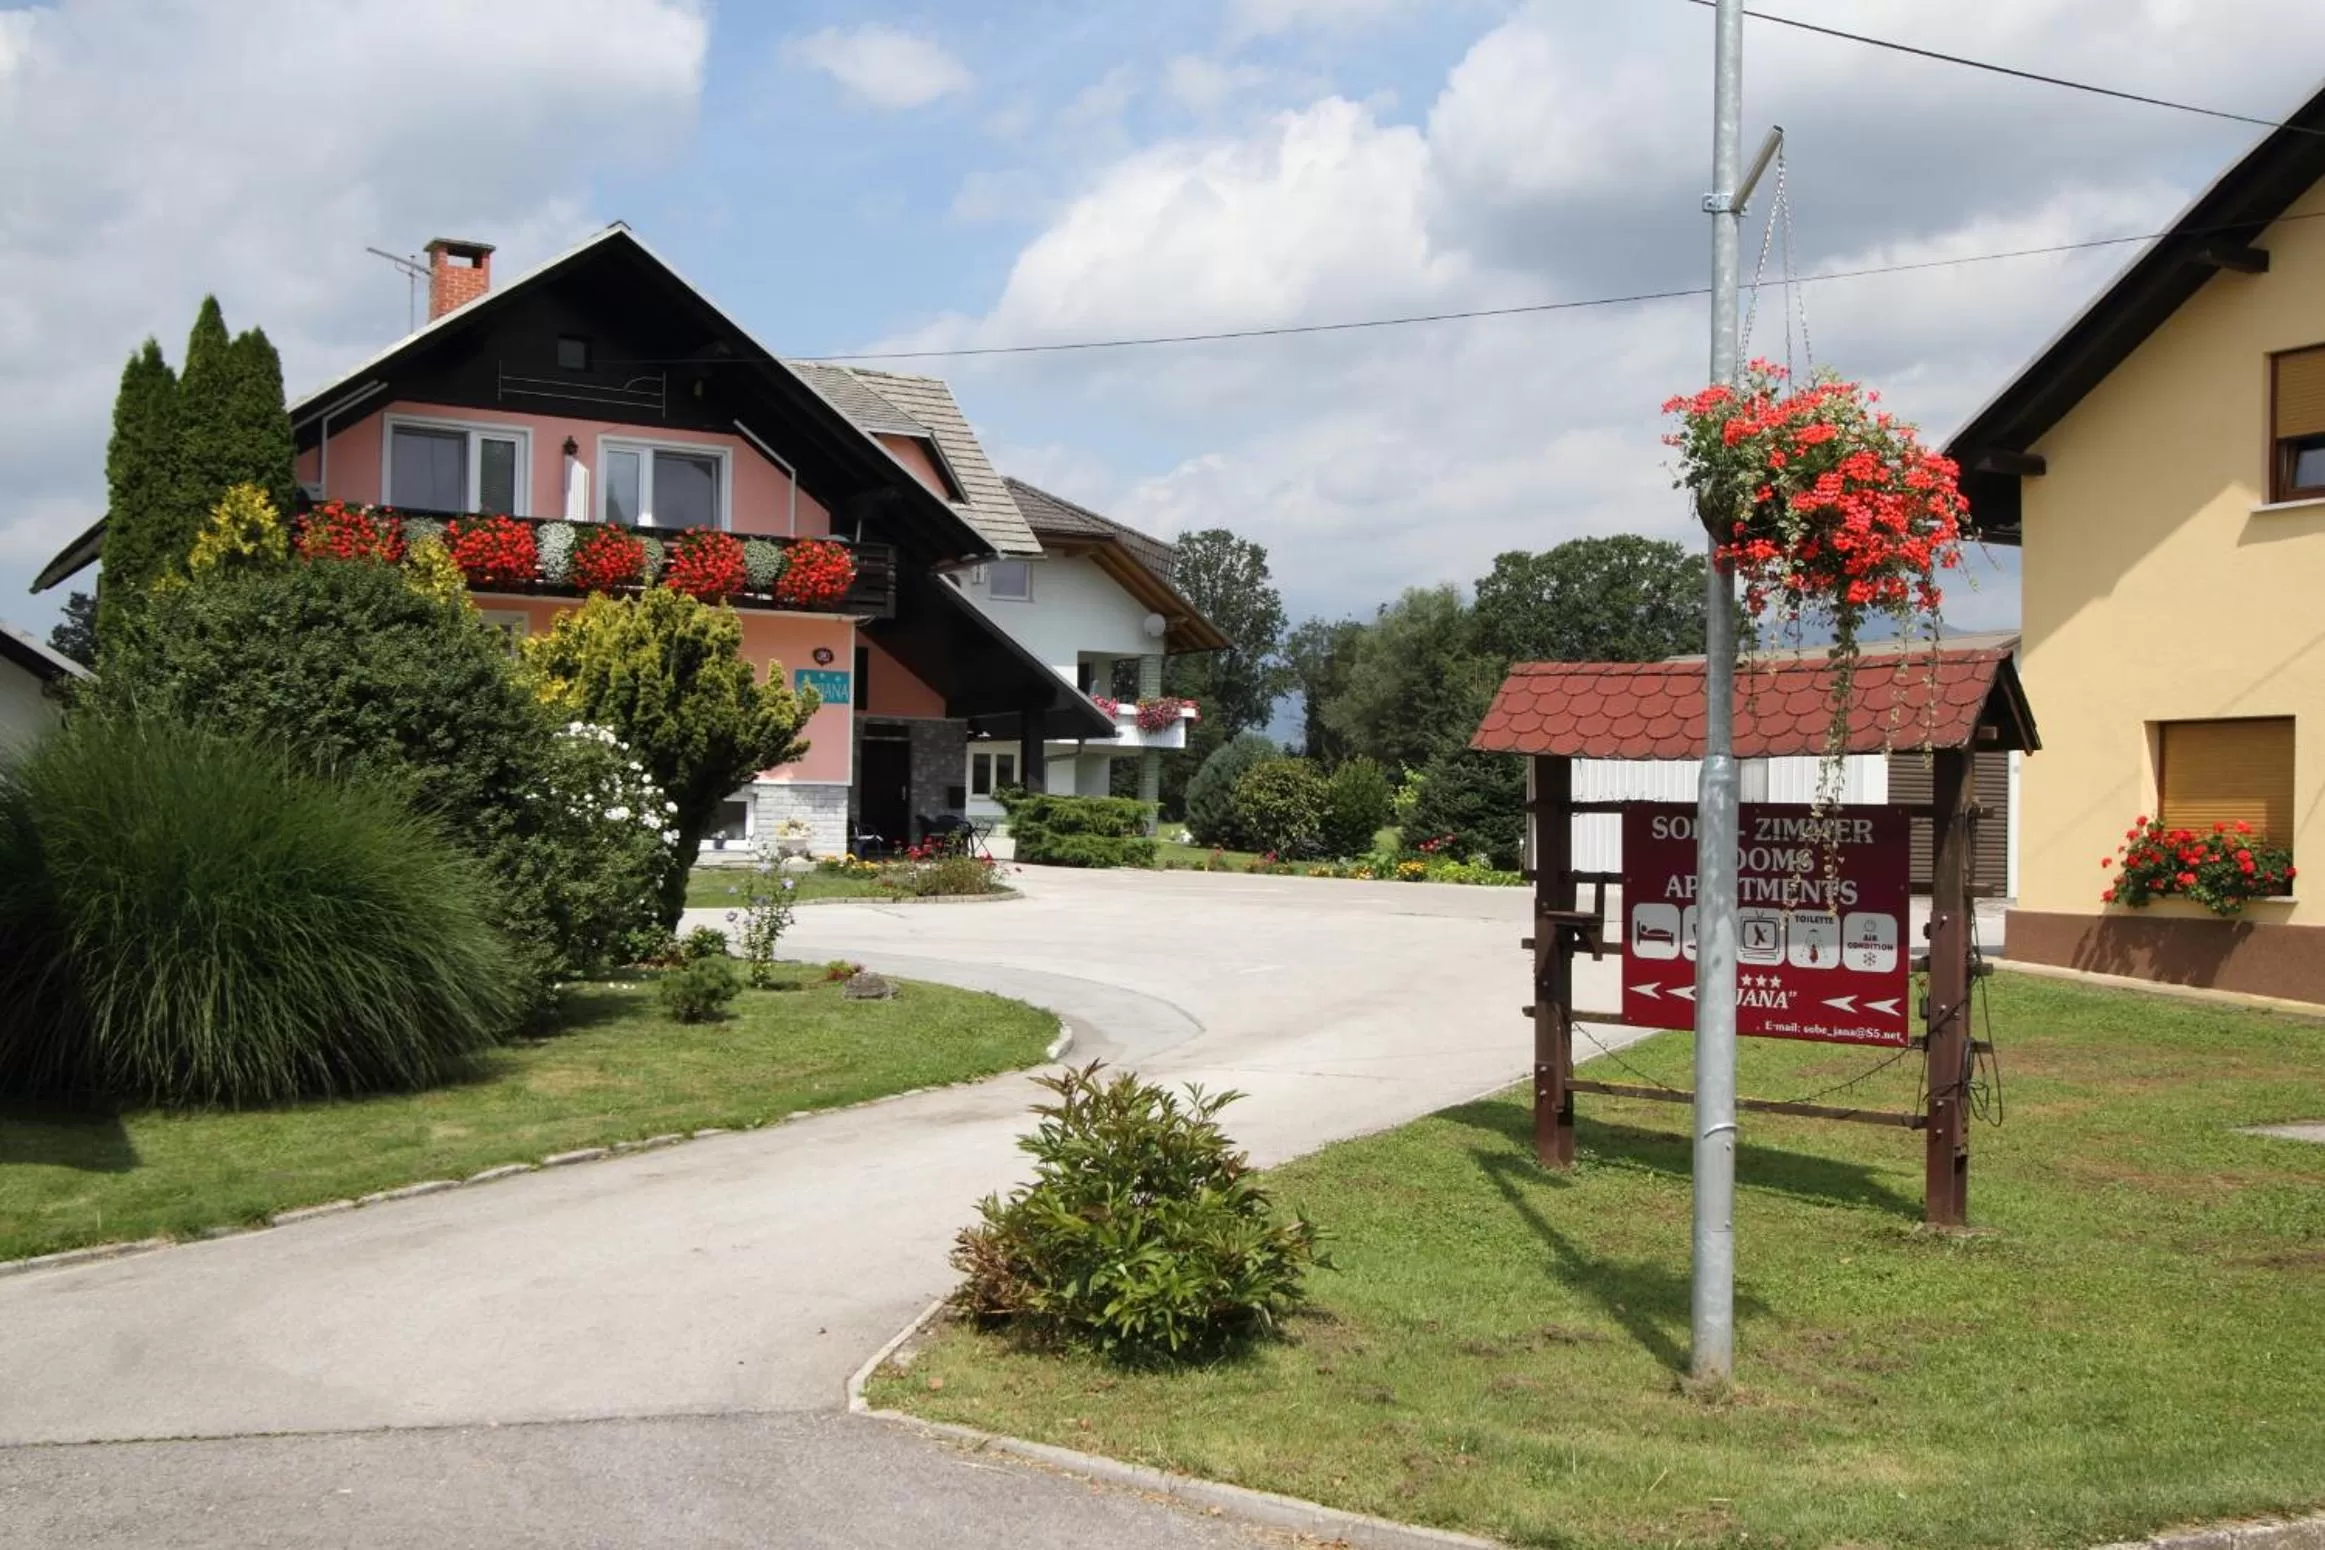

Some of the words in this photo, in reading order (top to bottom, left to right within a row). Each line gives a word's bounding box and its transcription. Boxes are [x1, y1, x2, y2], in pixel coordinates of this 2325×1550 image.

[1651, 816, 1698, 840] SO
[1753, 817, 1875, 844] ZIMMER
[1736, 846, 1815, 873] OMS
[1664, 873, 1859, 905] APTMENTS
[1794, 915, 1834, 925] TOILETTE
[1862, 934, 1878, 942] AIR
[1847, 942, 1894, 951] CONDITION
[1765, 1020, 1801, 1033] E-mail:
